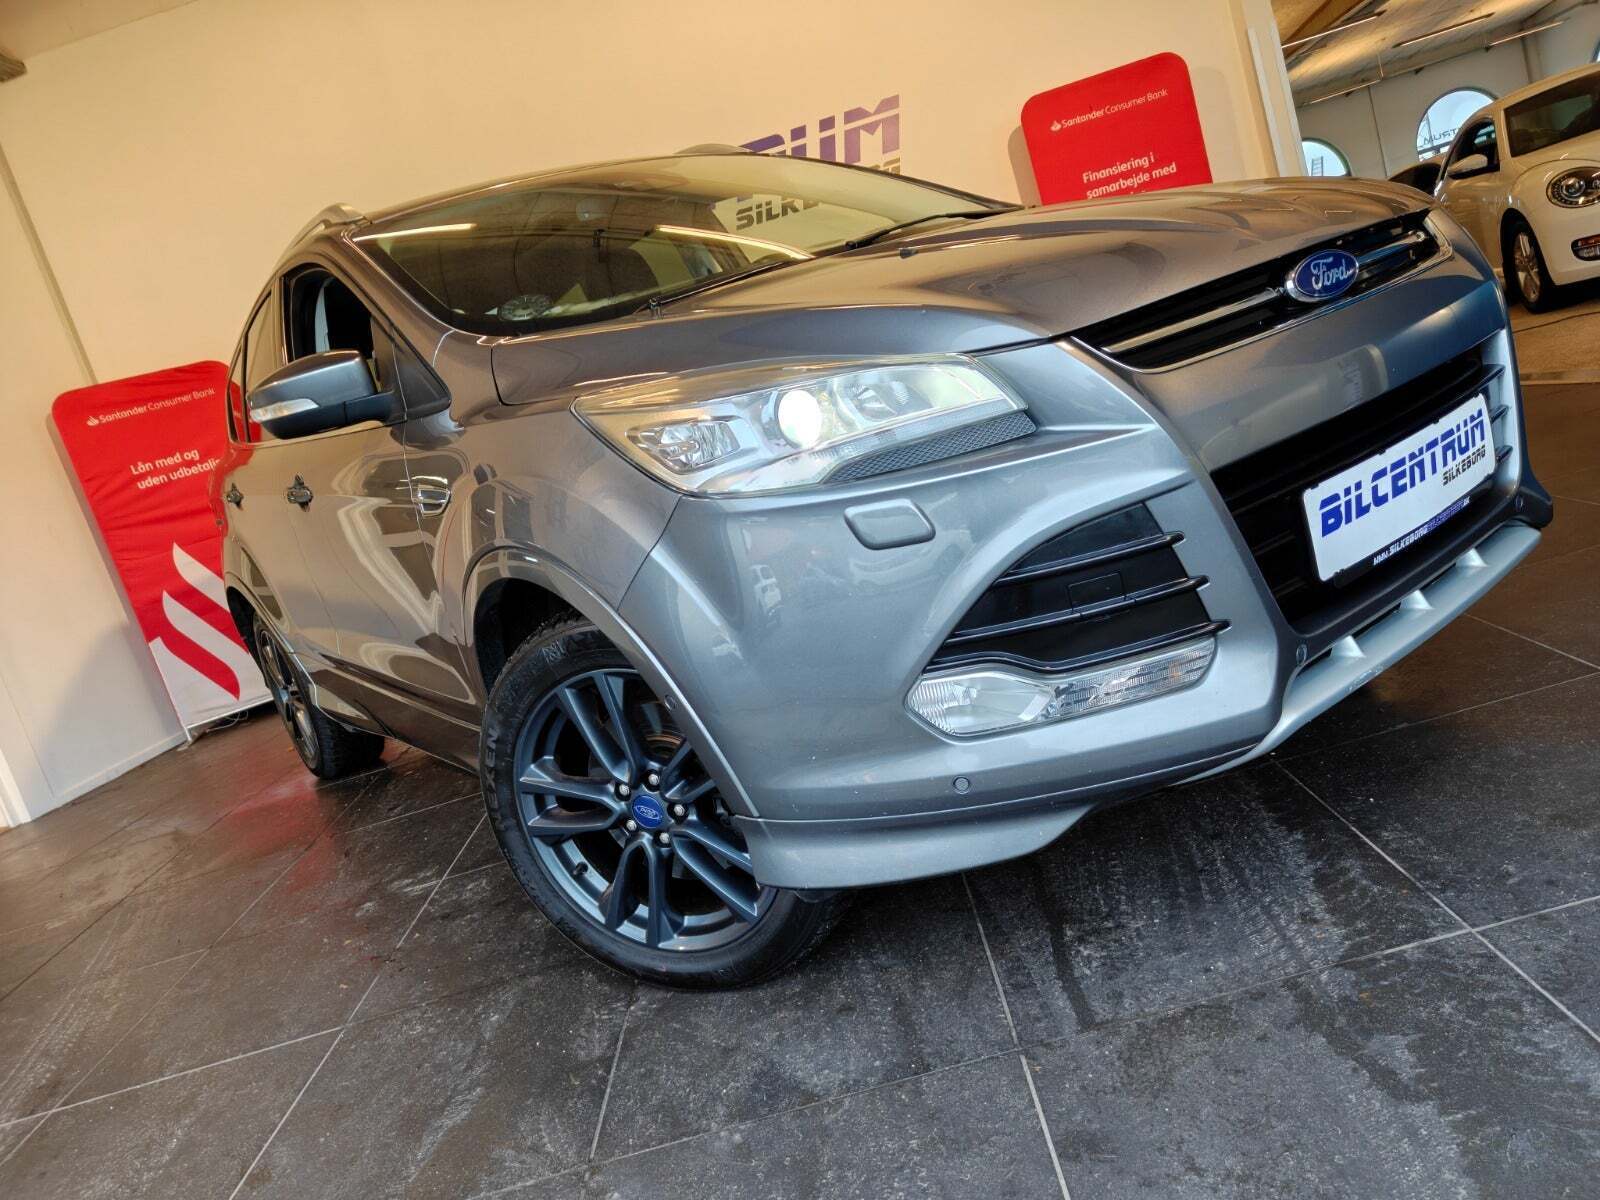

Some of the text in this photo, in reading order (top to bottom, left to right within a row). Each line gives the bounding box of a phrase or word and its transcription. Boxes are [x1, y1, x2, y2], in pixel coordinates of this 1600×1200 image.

[1062, 89, 1168, 128] Santander Consumer Bank
[1082, 152, 1155, 183] Finansiering i
[1086, 162, 1177, 199] samarbejde med
[736, 200, 818, 231] SILK
[1310, 257, 1358, 290] Ford
[99, 388, 216, 423] Santander Consumer Bank
[130, 449, 199, 475] Lån med og
[1319, 408, 1485, 537] BILCENTRUM
[137, 474, 168, 489] uden
